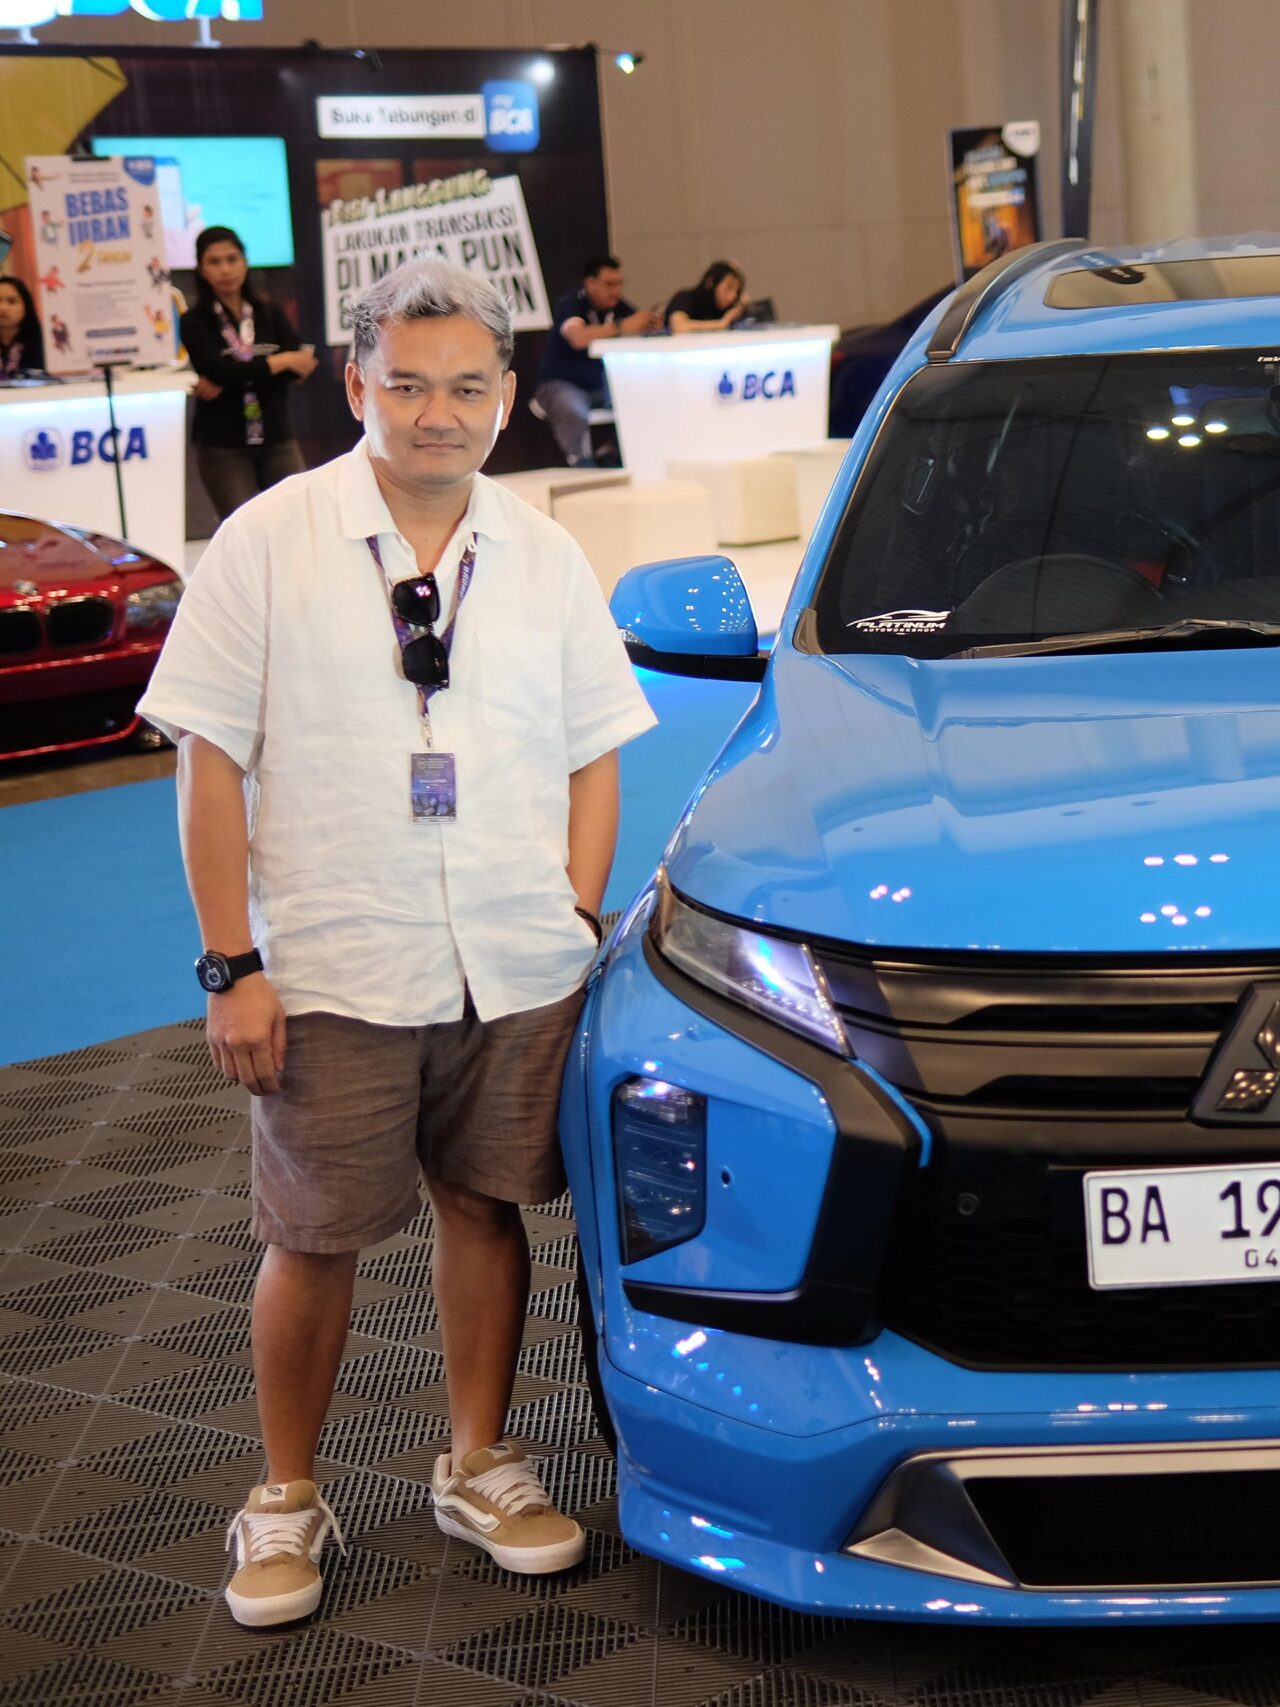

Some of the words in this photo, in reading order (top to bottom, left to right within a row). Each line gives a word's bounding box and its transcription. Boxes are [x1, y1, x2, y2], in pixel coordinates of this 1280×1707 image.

[64, 187, 129, 218] BEBAS
[414, 203, 519, 241] TRANSAKSI
[336, 256, 361, 291] DI
[461, 231, 526, 273] PUN
[743, 370, 795, 400] BCA
[71, 427, 148, 465] BCA
[1101, 1185, 1171, 1246] BA
